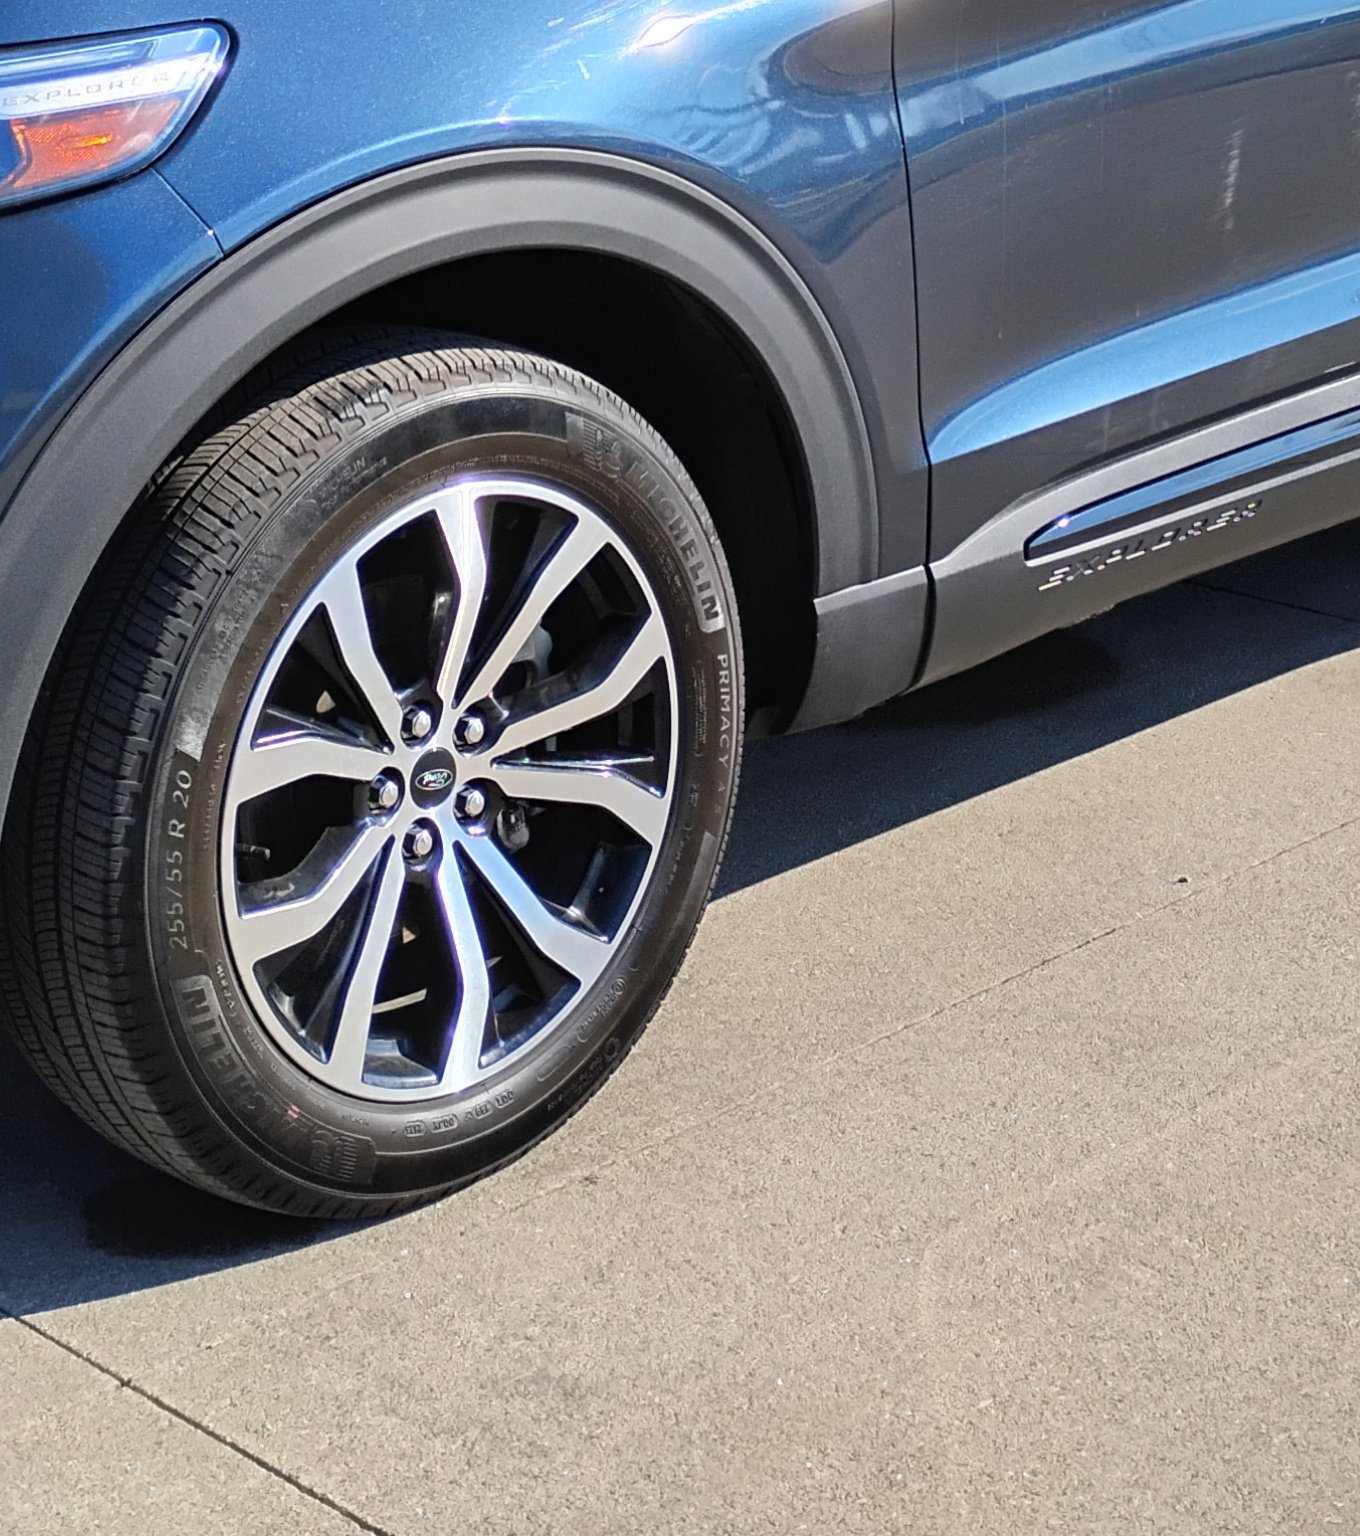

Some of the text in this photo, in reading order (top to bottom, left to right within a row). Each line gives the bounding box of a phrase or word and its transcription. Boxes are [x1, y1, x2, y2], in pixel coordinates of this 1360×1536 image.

[625, 460, 720, 622] MICHELIN
[1039, 499, 1262, 592] EXPLORER
[716, 653, 732, 769] PRIMACY
[165, 769, 193, 951] 255/55 R 20
